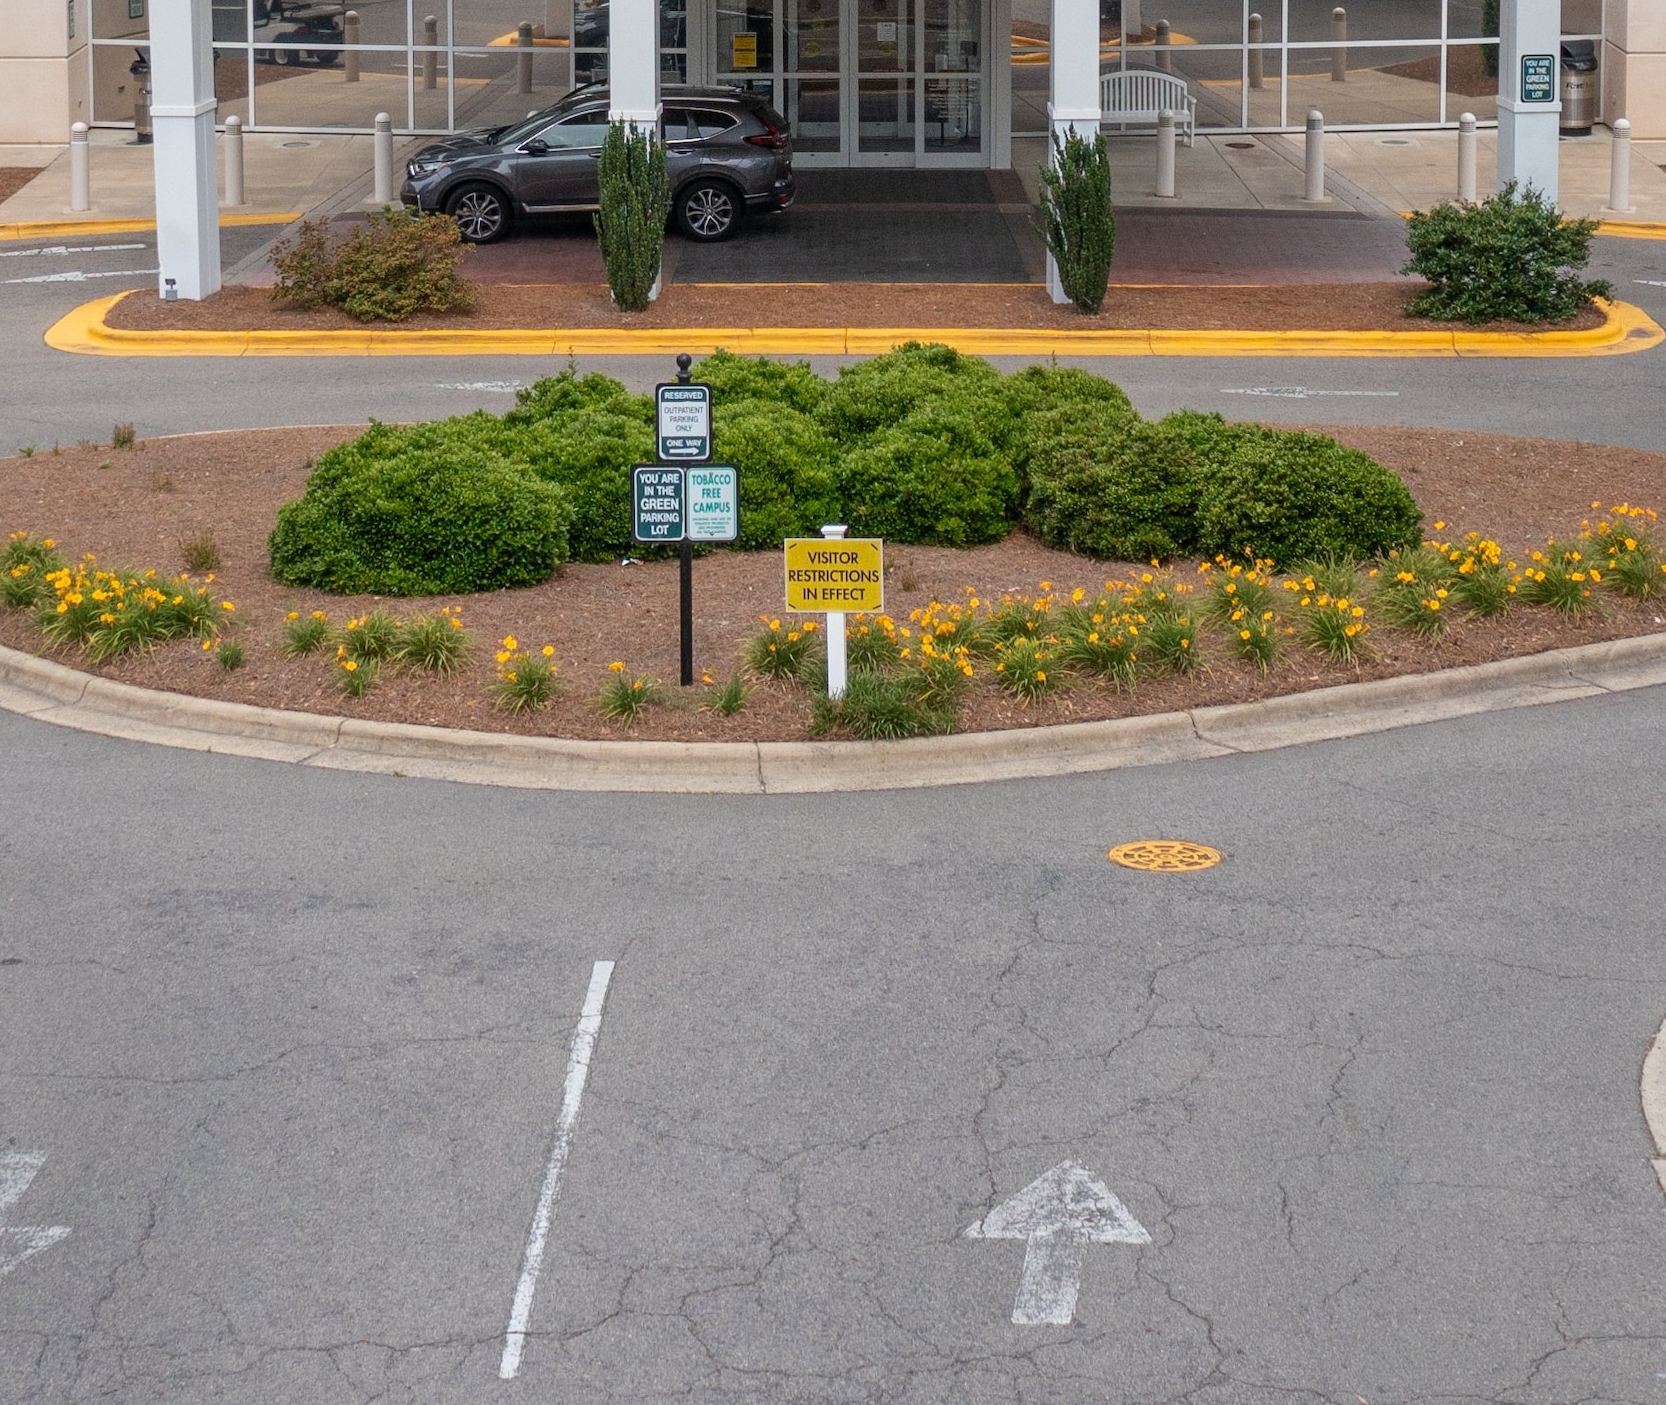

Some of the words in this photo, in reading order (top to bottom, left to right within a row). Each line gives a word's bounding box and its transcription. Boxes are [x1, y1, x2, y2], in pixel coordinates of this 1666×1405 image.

[1526, 75, 1549, 83] GREEN
[640, 474, 659, 484] YOU
[661, 474, 679, 483] ARE
[692, 475, 731, 485] TOBACCO
[644, 486, 653, 495] IN
[656, 486, 675, 495] THE
[702, 488, 721, 498] FREE
[640, 498, 679, 510] GREEN
[693, 502, 730, 513] CAMPUS
[640, 513, 679, 522] PARKING
[651, 525, 669, 535] LOT
[808, 552, 858, 564] VISITOR
[788, 570, 879, 582] RESTRICTIONS
[803, 588, 817, 600] IN
[822, 589, 865, 600] EFFECT
